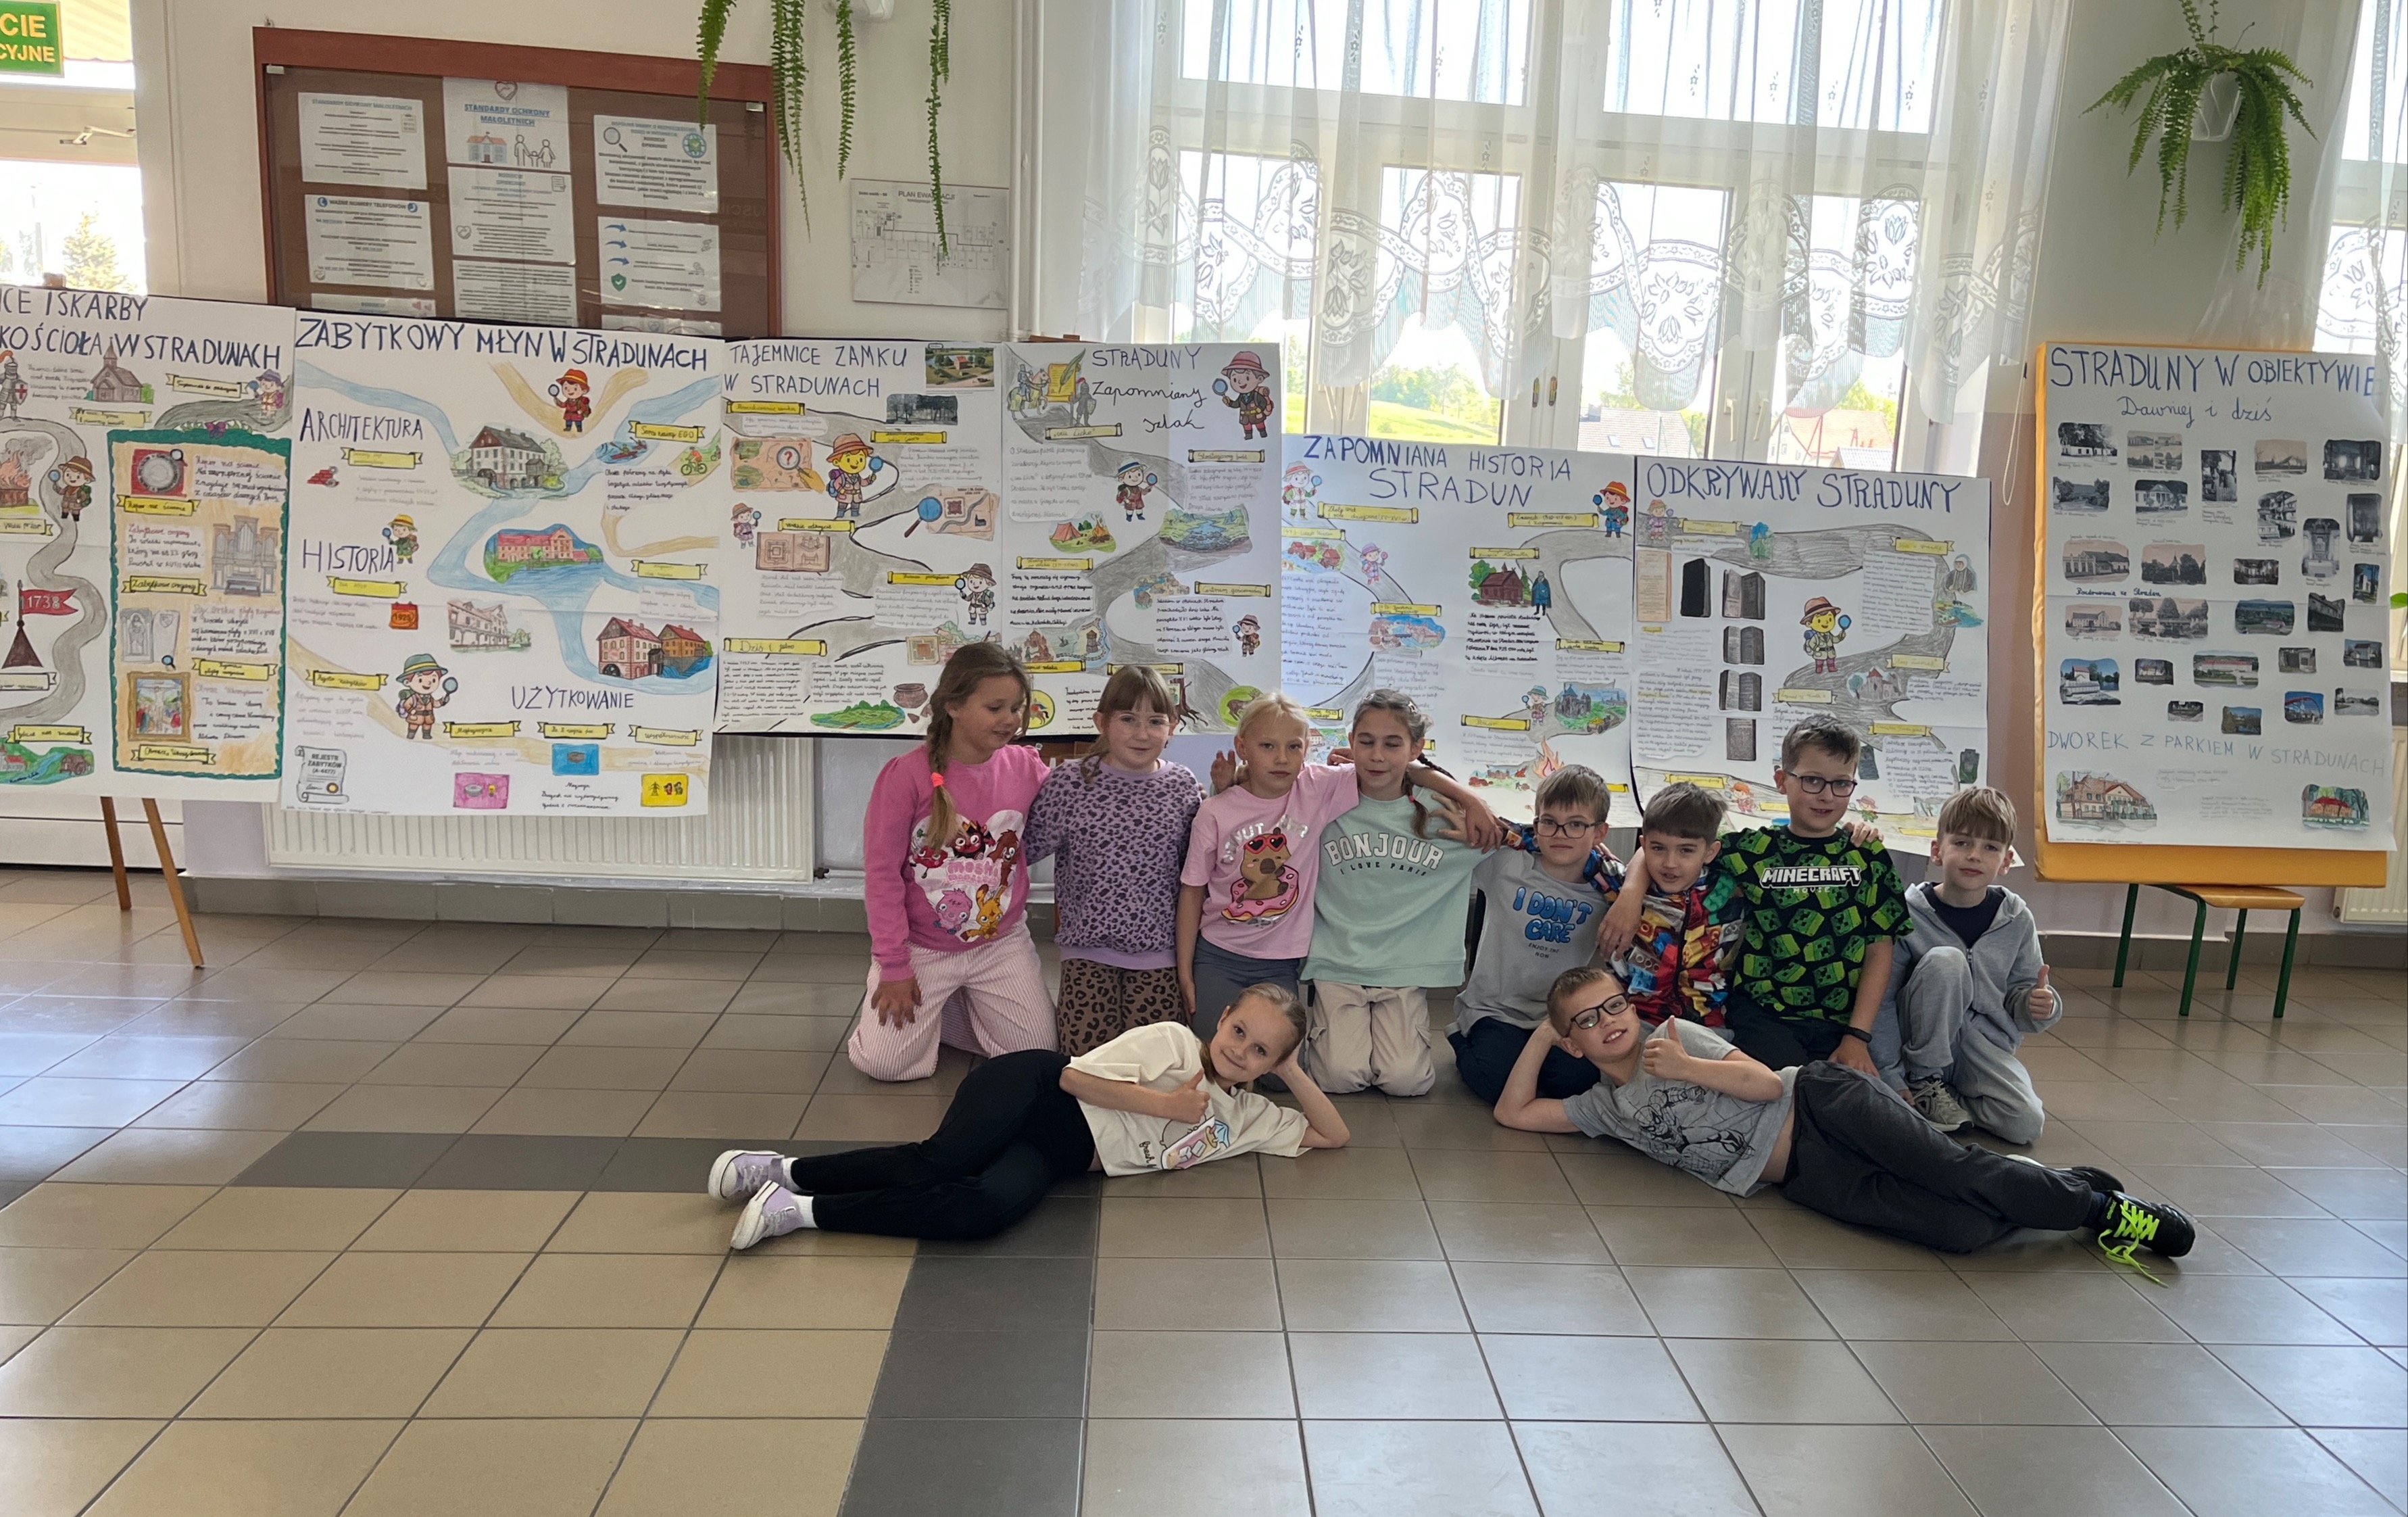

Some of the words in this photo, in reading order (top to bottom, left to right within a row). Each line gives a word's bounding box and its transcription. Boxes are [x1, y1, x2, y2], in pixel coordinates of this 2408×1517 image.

[464, 103, 510, 114] STANDARDY
[512, 107, 550, 118] OCHRONY
[917, 192, 955, 201] EWAACJI
[58, 292, 148, 322] SKARBY
[114, 333, 140, 358] W
[145, 334, 281, 370] STRADUNACH
[295, 318, 466, 351] ZABYTKOWY
[476, 328, 543, 357] MŁYN
[550, 330, 566, 363] W
[572, 332, 708, 371] STRADUNACH
[730, 344, 821, 367] TAJEMNICE
[835, 345, 907, 368] ZAMKU
[1091, 345, 1202, 371] STRADUNY
[724, 372, 739, 391] W
[751, 375, 880, 398] STRADUNACH
[2050, 347, 2205, 393] STRADUNY
[2214, 354, 2240, 387] W
[2248, 357, 2384, 397] OBIEKTYWIE
[1091, 380, 1208, 408] Zapomniany
[299, 407, 424, 443] ARCHITEKTURA
[2117, 395, 2196, 429] Dawniej
[2205, 403, 2218, 418] i
[2232, 396, 2273, 423] dziś
[1303, 435, 1448, 468] ZAPOMNIANA
[1469, 451, 1571, 481] HISTORIA
[1369, 468, 1533, 508] STRADUN
[1647, 462, 1807, 502] ODKRYWAMY
[1817, 473, 1961, 513] STRADUNY
[302, 539, 394, 575] HISTORIA
[27, 595, 60, 610] 1738
[511, 685, 635, 711] UŻYTKOWANIE
[307, 759, 343, 770] ZABYTKÓW
[311, 753, 339, 762] REJESTR
[2047, 730, 2129, 750] DWOREK
[2140, 733, 2155, 747] Z
[2165, 735, 2234, 756] PARKIEM
[2249, 740, 2263, 761] W
[2271, 748, 2385, 778] STRADUNACH
[1323, 832, 1445, 871] BONJOUR
[1350, 861, 1381, 871] LOVE
[1390, 862, 1427, 877] PARIS
[1760, 866, 1862, 888] MINECRAFT
[1792, 886, 1831, 894] MOVIE
[1513, 886, 1527, 911] I
[1526, 891, 1594, 925] DON'T
[1525, 918, 1576, 944] CARE
[1527, 942, 1548, 952] ENJOY
[1534, 951, 1550, 959] NOW
